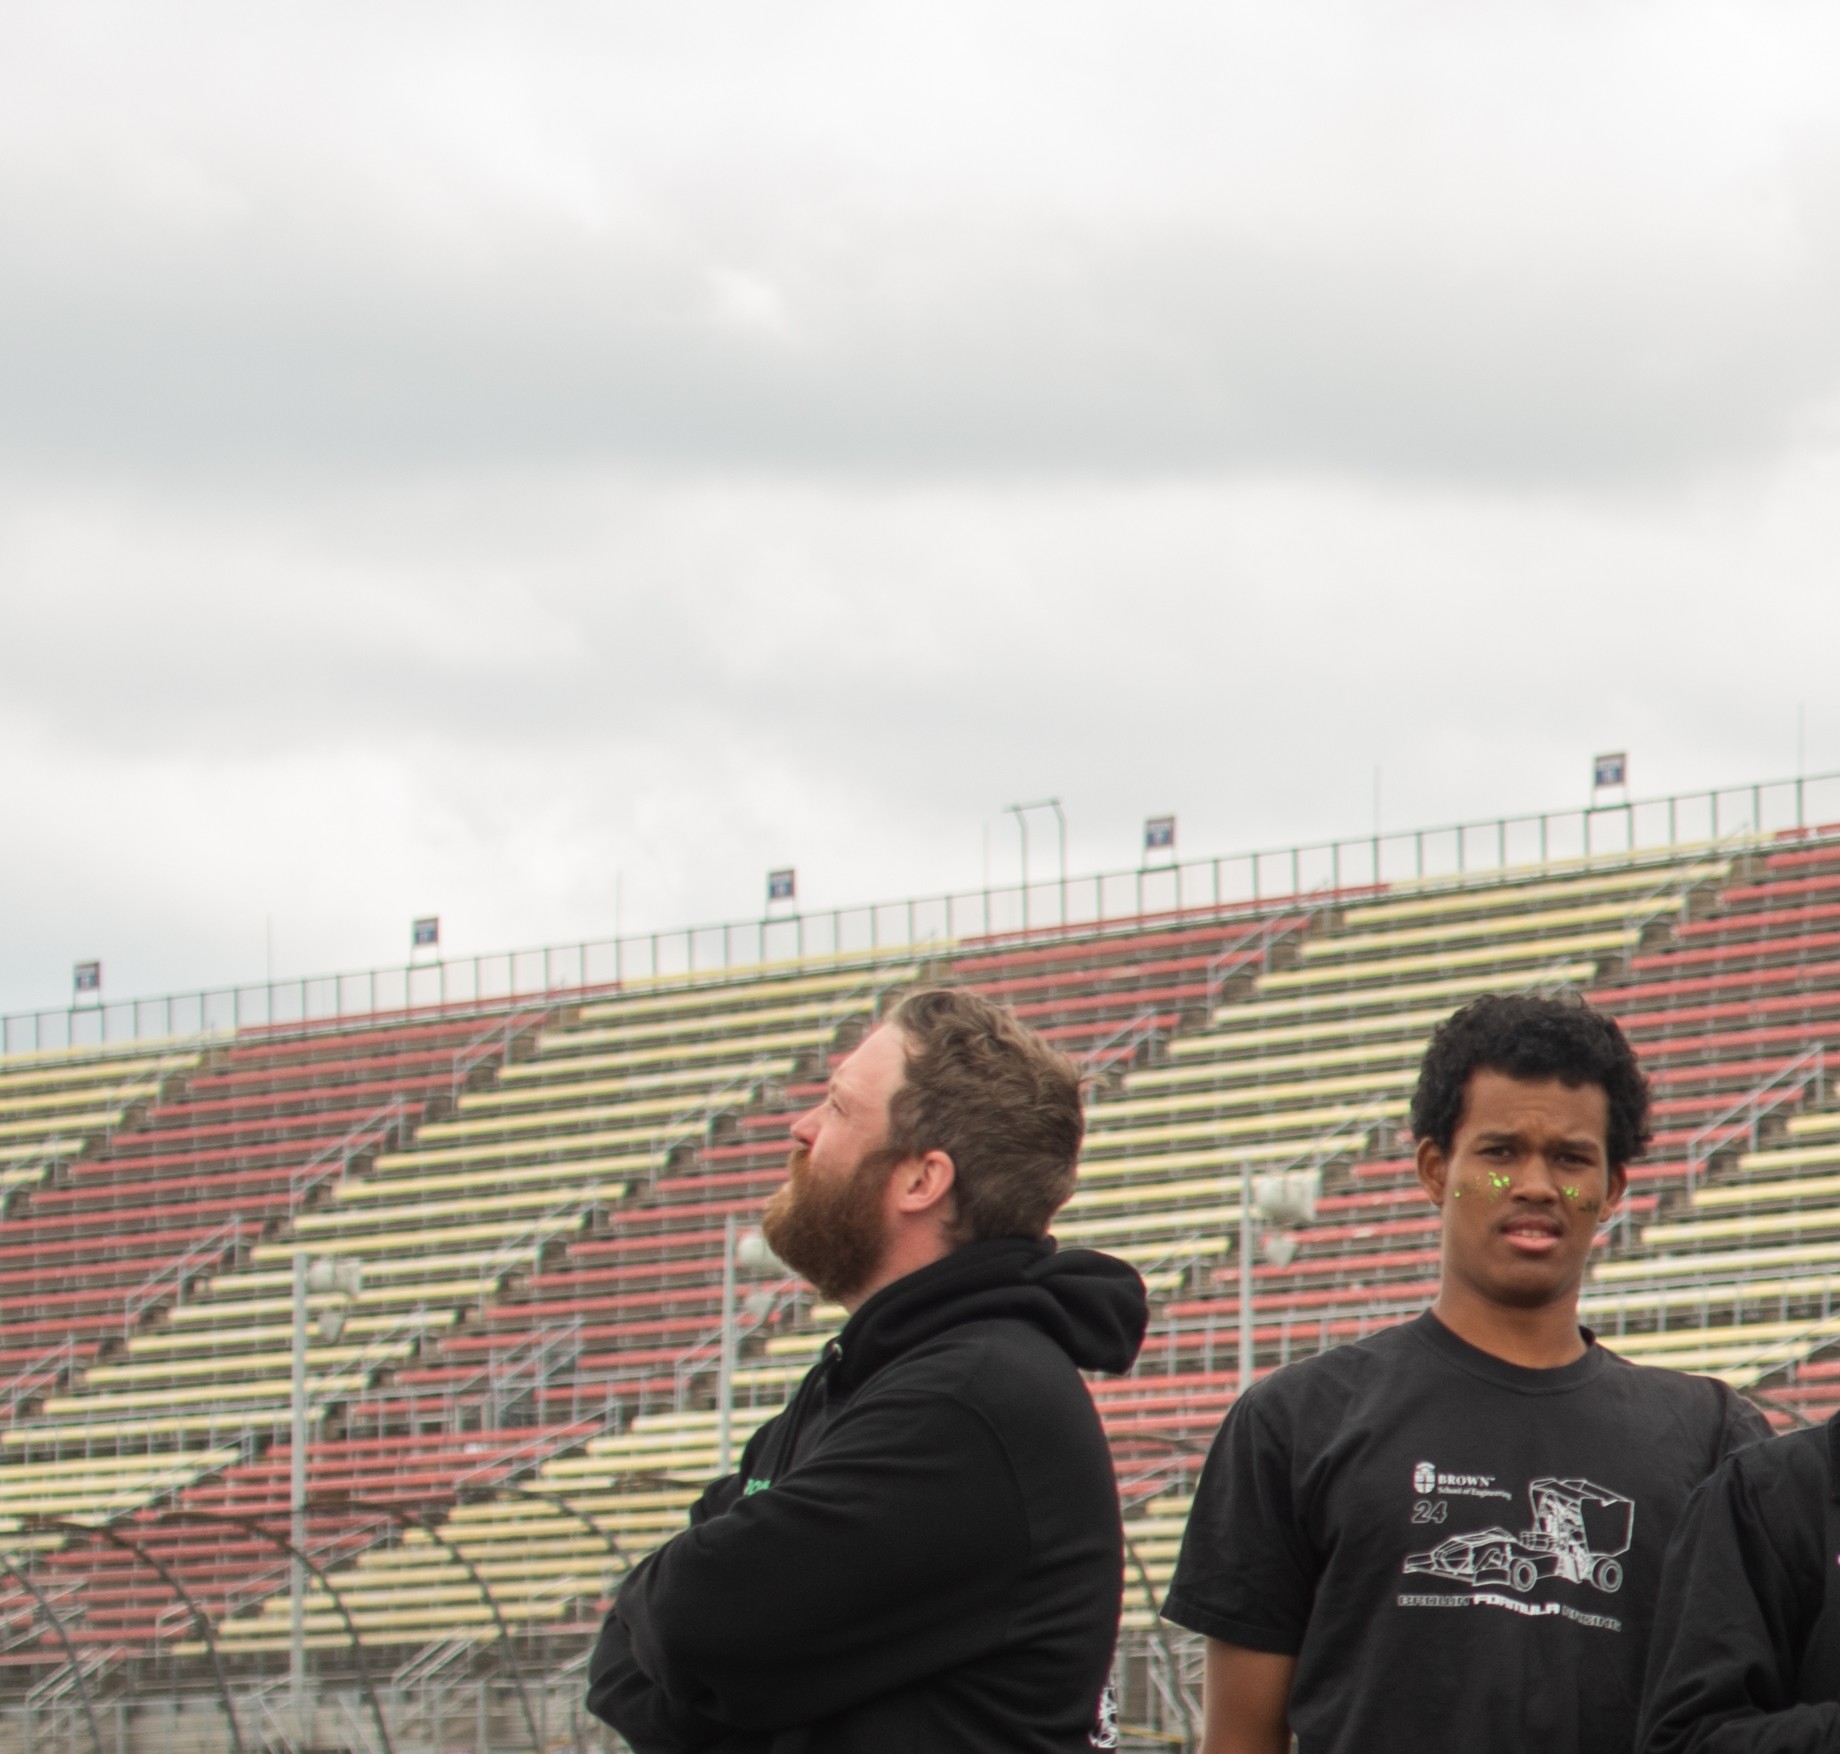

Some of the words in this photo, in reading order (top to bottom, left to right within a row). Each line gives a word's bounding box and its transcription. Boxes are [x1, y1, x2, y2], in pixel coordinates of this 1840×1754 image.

[1438, 1474, 1491, 1488] BROWN
[1411, 1501, 1448, 1524] 24
[1473, 1593, 1561, 1616] FORMULA
